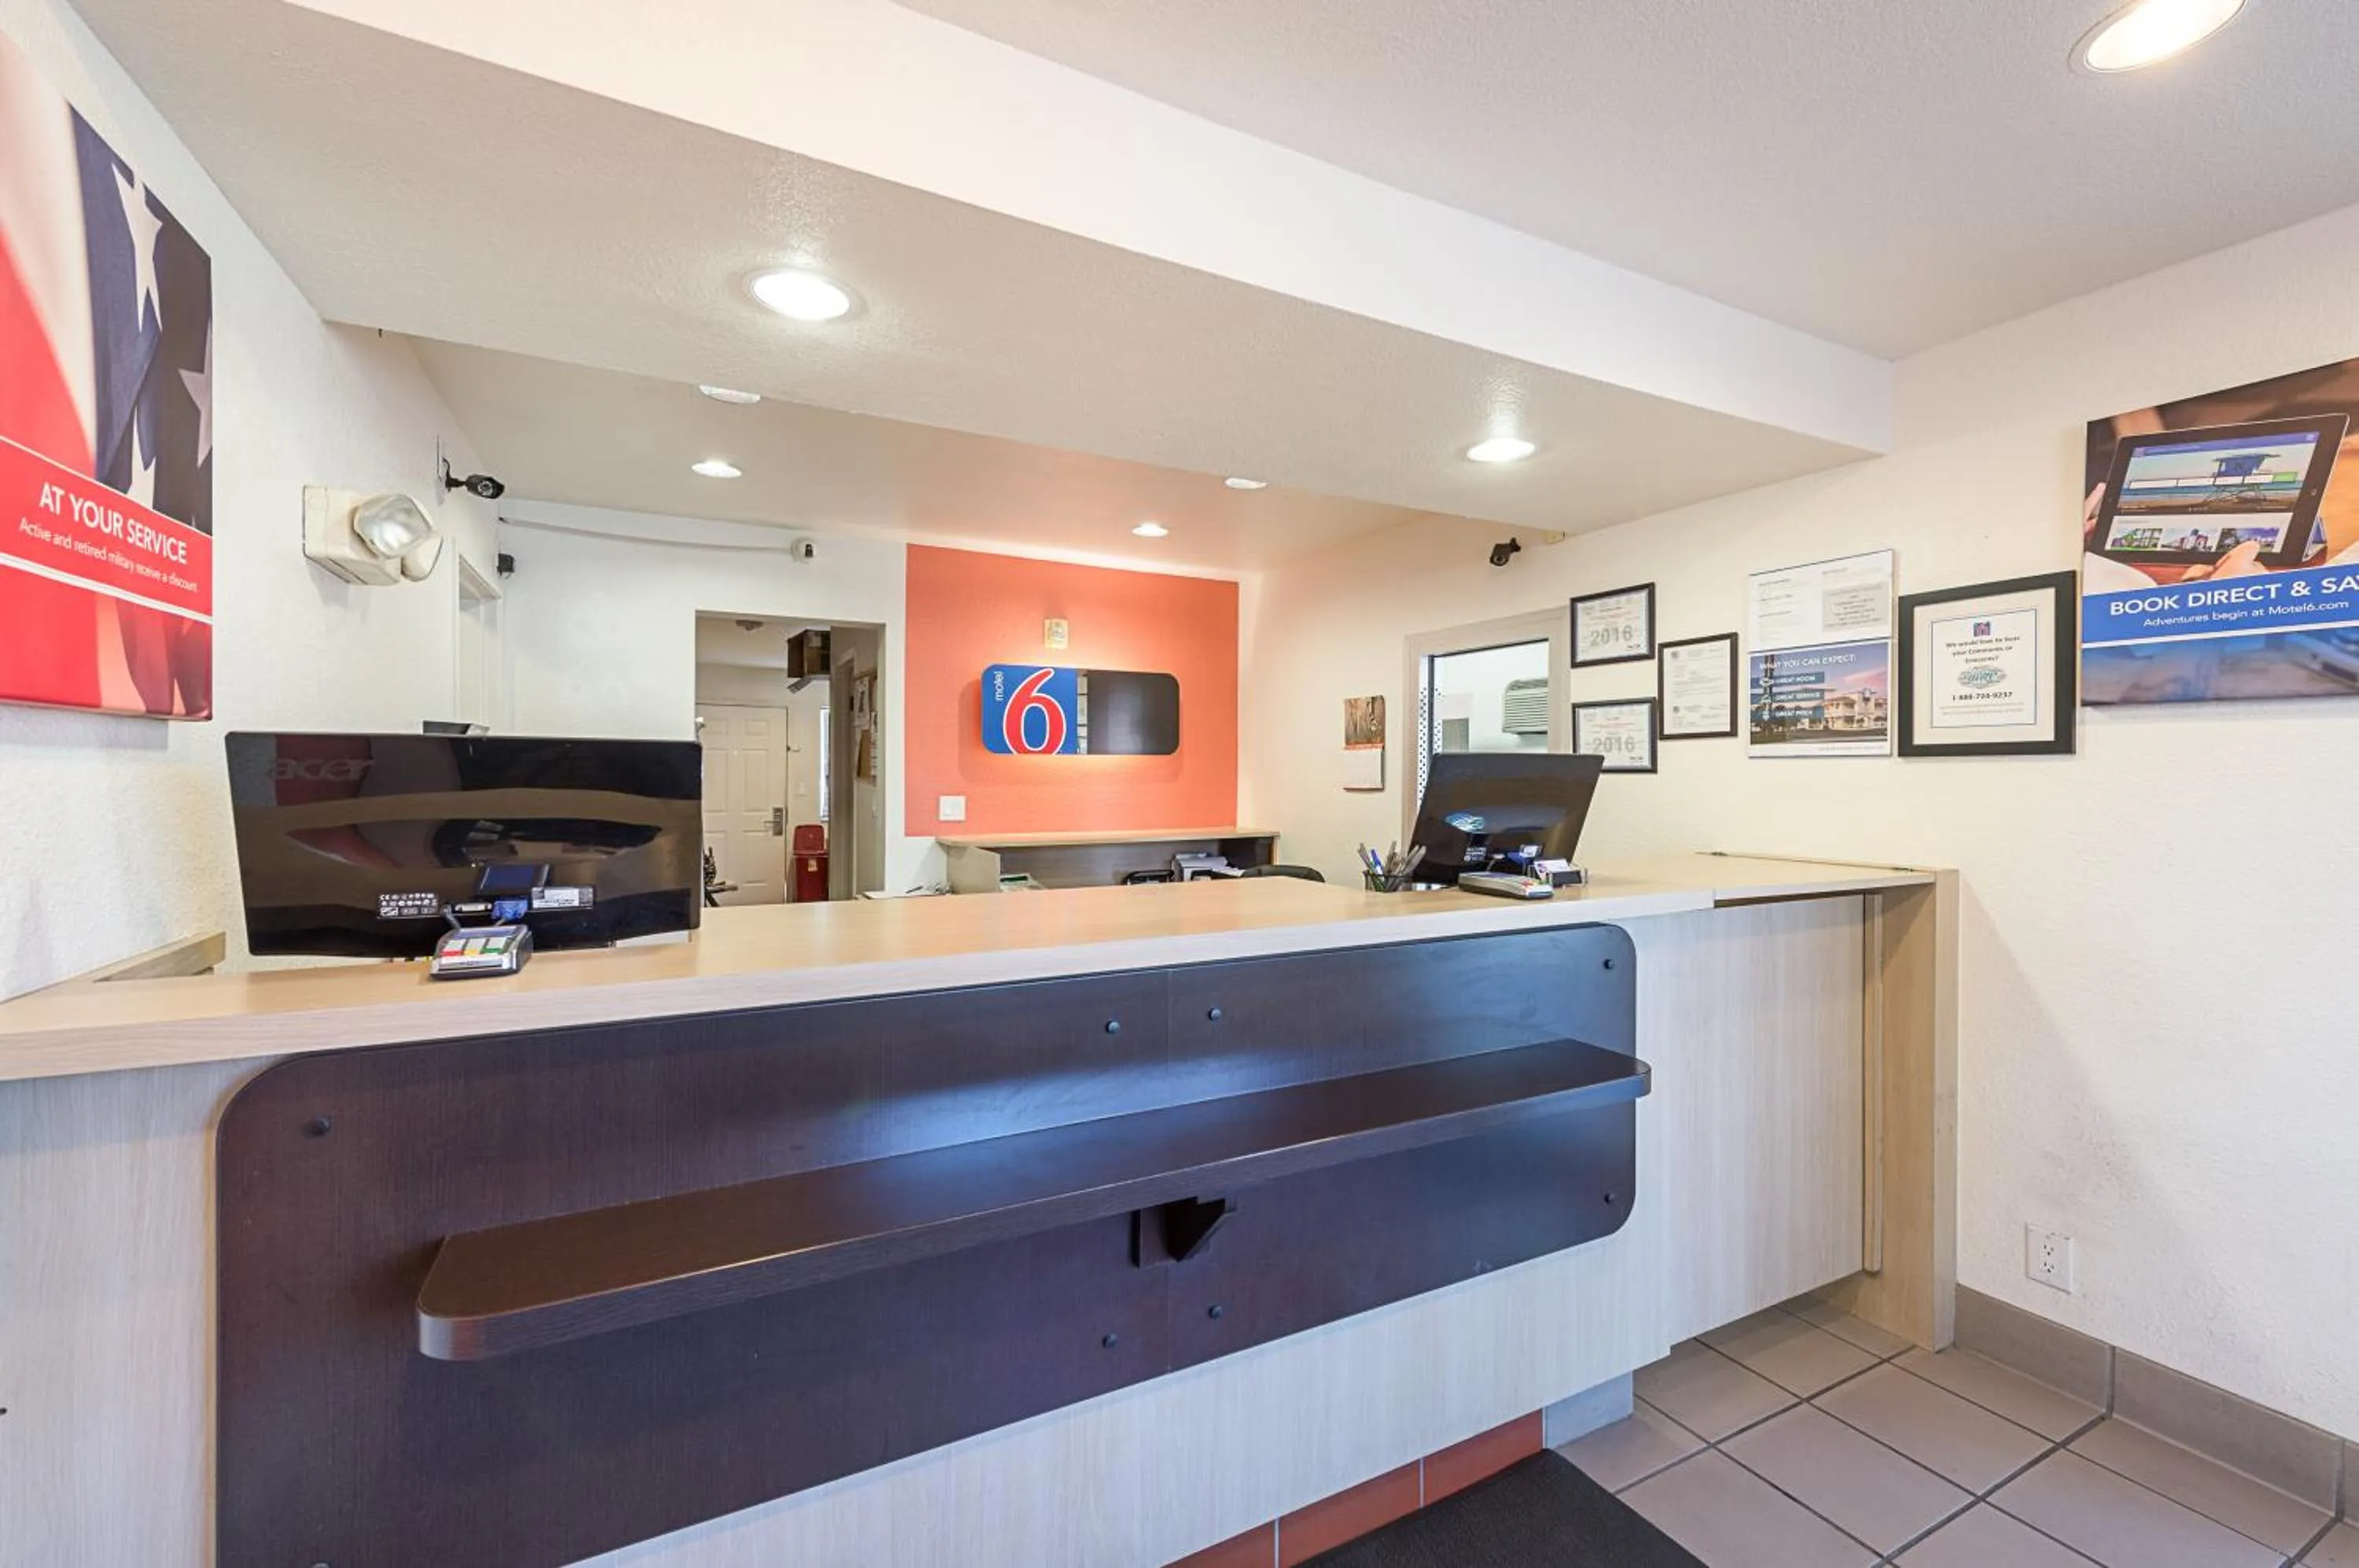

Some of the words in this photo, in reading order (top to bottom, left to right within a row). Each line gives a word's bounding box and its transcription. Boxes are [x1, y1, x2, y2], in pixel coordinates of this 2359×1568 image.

[40, 481, 65, 515] AT
[68, 492, 123, 539] YOUR
[127, 518, 187, 565] SERVICE
[19, 517, 52, 542] Active
[53, 532, 72, 549] and
[74, 540, 107, 561] retired
[108, 550, 134, 573] military
[136, 561, 162, 582] receive
[162, 574, 168, 583] a
[2110, 594, 2180, 616] BOOK
[2188, 583, 2283, 608] DIRECT
[2290, 581, 2312, 598] &
[2143, 614, 2210, 627] Adventures
[2212, 610, 2247, 621] begin
[2251, 609, 2265, 618] at
[2268, 600, 2350, 616] Motel6.com
[1589, 625, 1633, 647] 2016
[1783, 659, 1800, 668] YOU
[1801, 657, 1820, 667] CAN
[993, 671, 1004, 701] motel
[1003, 667, 1066, 755] 6
[1591, 736, 1636, 754] 2016
[265, 757, 376, 781] acer
